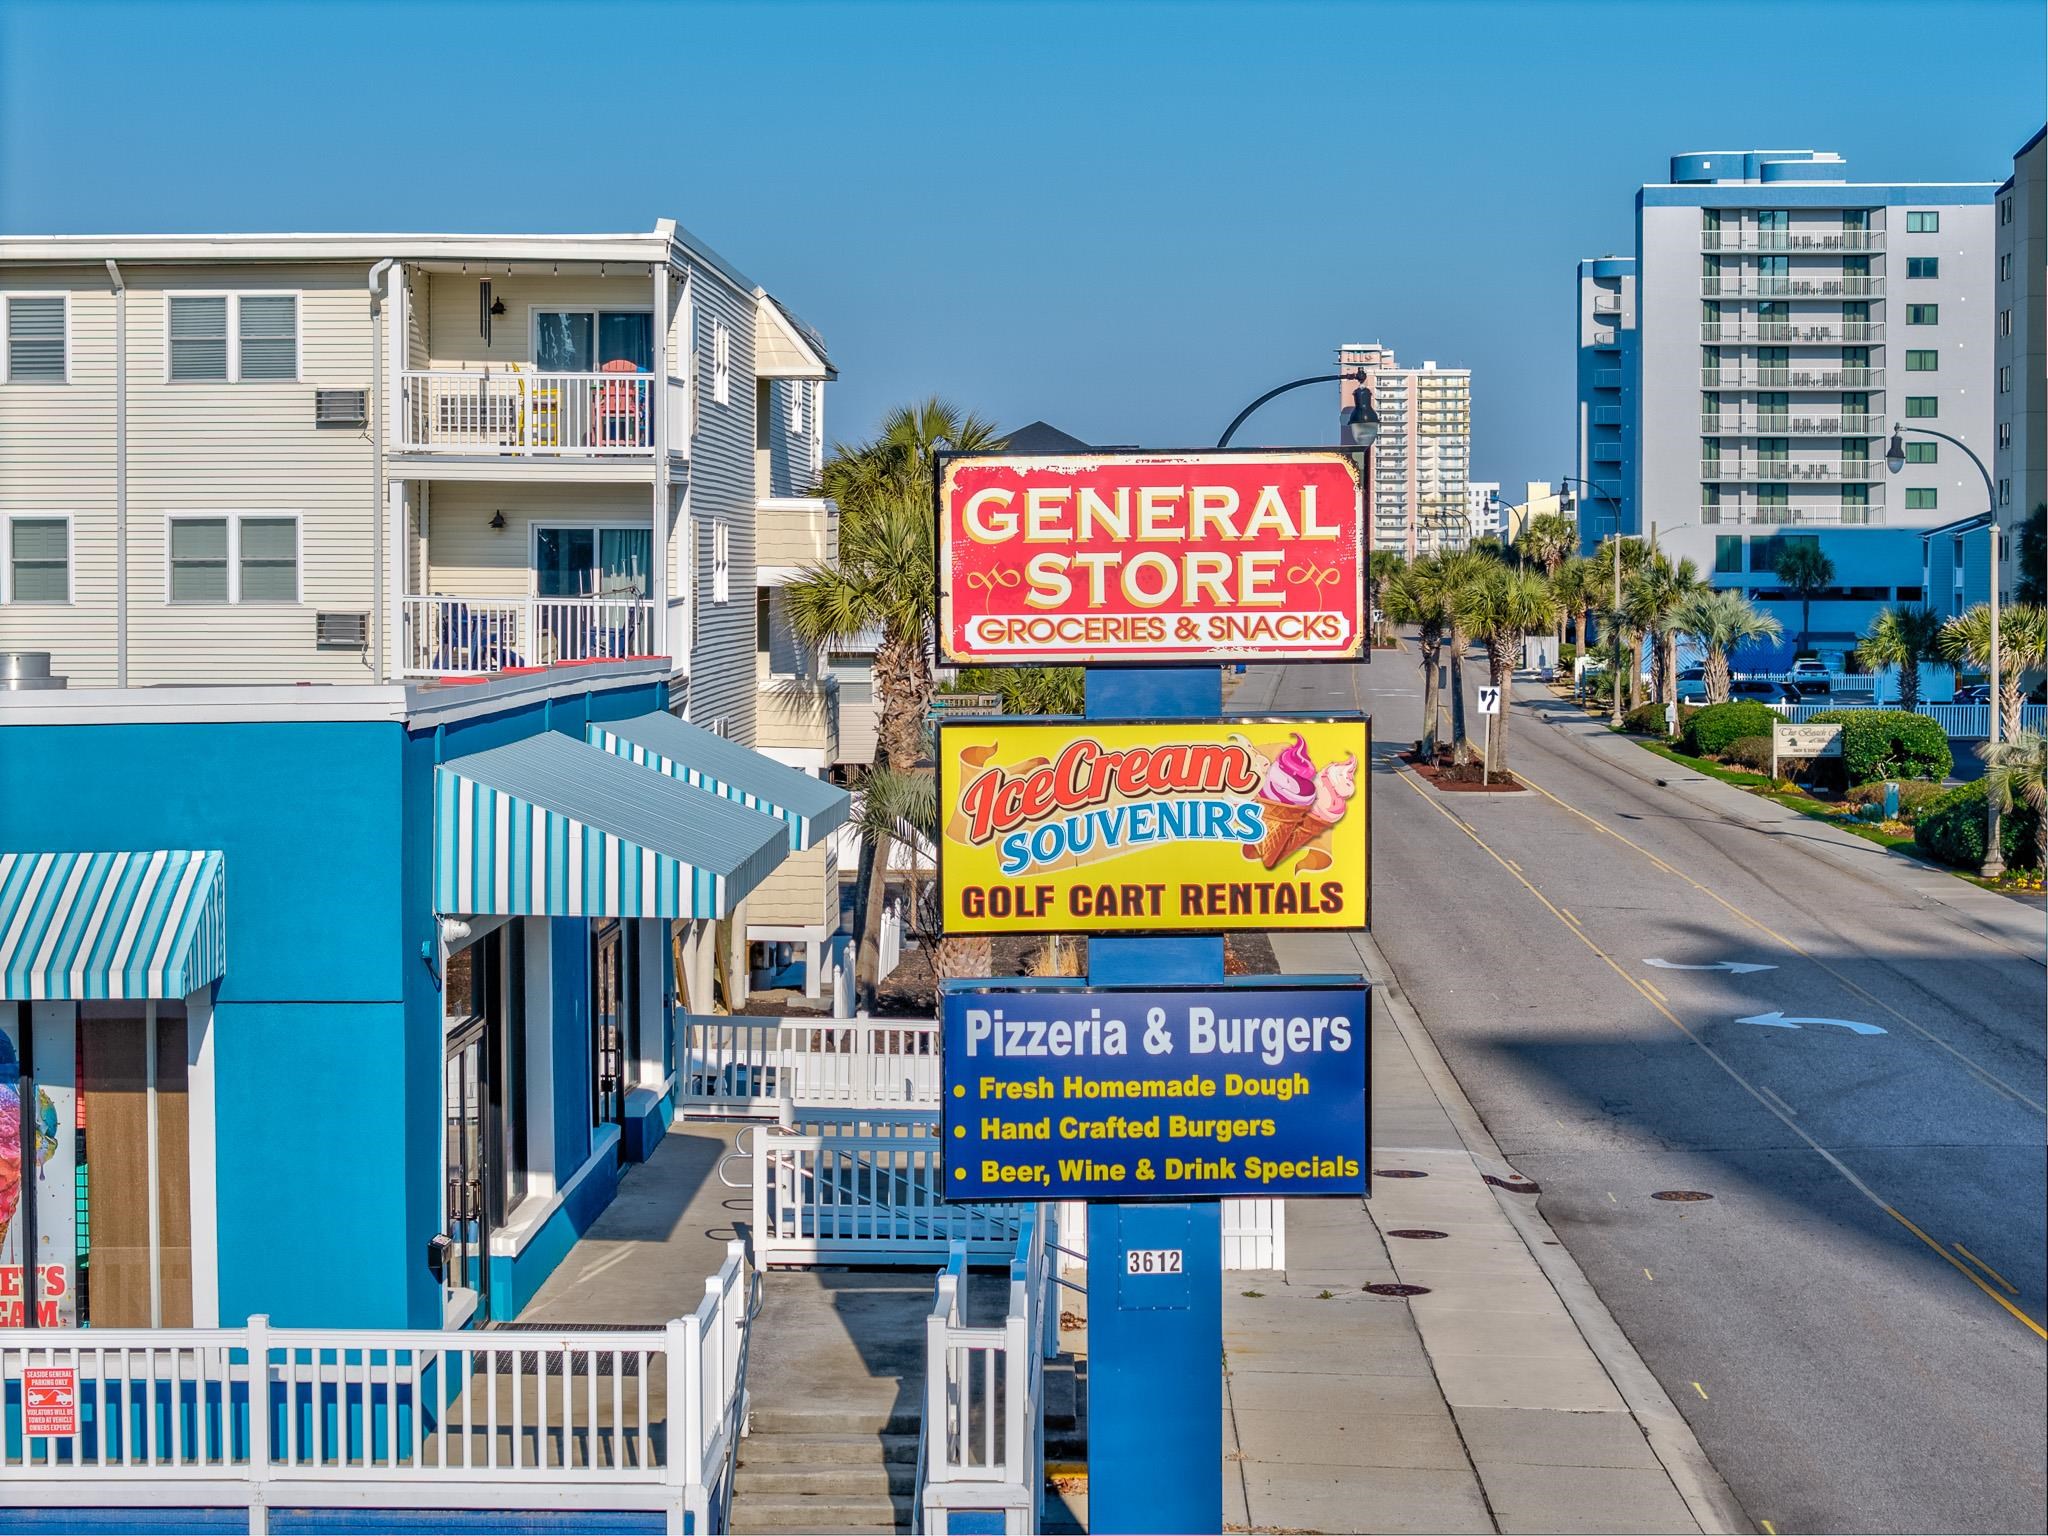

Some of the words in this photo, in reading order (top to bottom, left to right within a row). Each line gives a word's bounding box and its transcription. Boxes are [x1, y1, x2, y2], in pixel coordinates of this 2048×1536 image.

[962, 484, 1340, 544] GENERAL
[1025, 549, 1286, 609] STORE
[977, 616, 1166, 645] GROCERIES
[1176, 616, 1201, 642] &
[1208, 614, 1341, 642] SNACKS
[1001, 800, 1266, 876] SOUVENIRS
[961, 884, 1055, 919] GOLF
[1069, 883, 1166, 917] CART
[1180, 881, 1344, 916] RENTALS
[966, 1008, 1128, 1057] Pizzeria
[1143, 1006, 1174, 1055] &
[1189, 1006, 1352, 1066] Burgers
[979, 1076, 1054, 1100] Fresh
[1063, 1074, 1216, 1099] Homemade
[1225, 1072, 1310, 1101] Dough
[981, 1116, 1051, 1141] Hand
[1059, 1115, 1160, 1139] Crafted
[1169, 1115, 1276, 1143] Burgers
[981, 1160, 1051, 1187] Beer,
[1058, 1158, 1126, 1181] Wine
[1135, 1158, 1156, 1181] &
[1165, 1156, 1236, 1180] Drink
[1244, 1155, 1359, 1184] Specials
[1128, 1251, 1181, 1273] 3612
[26, 1370, 49, 1378] SEASIDE
[49, 1370, 73, 1378] GENERAL
[27, 1408, 54, 1416] VIOLATORS
[28, 1416, 45, 1424] TOWED
[29, 1424, 50, 1432] OWNERS
